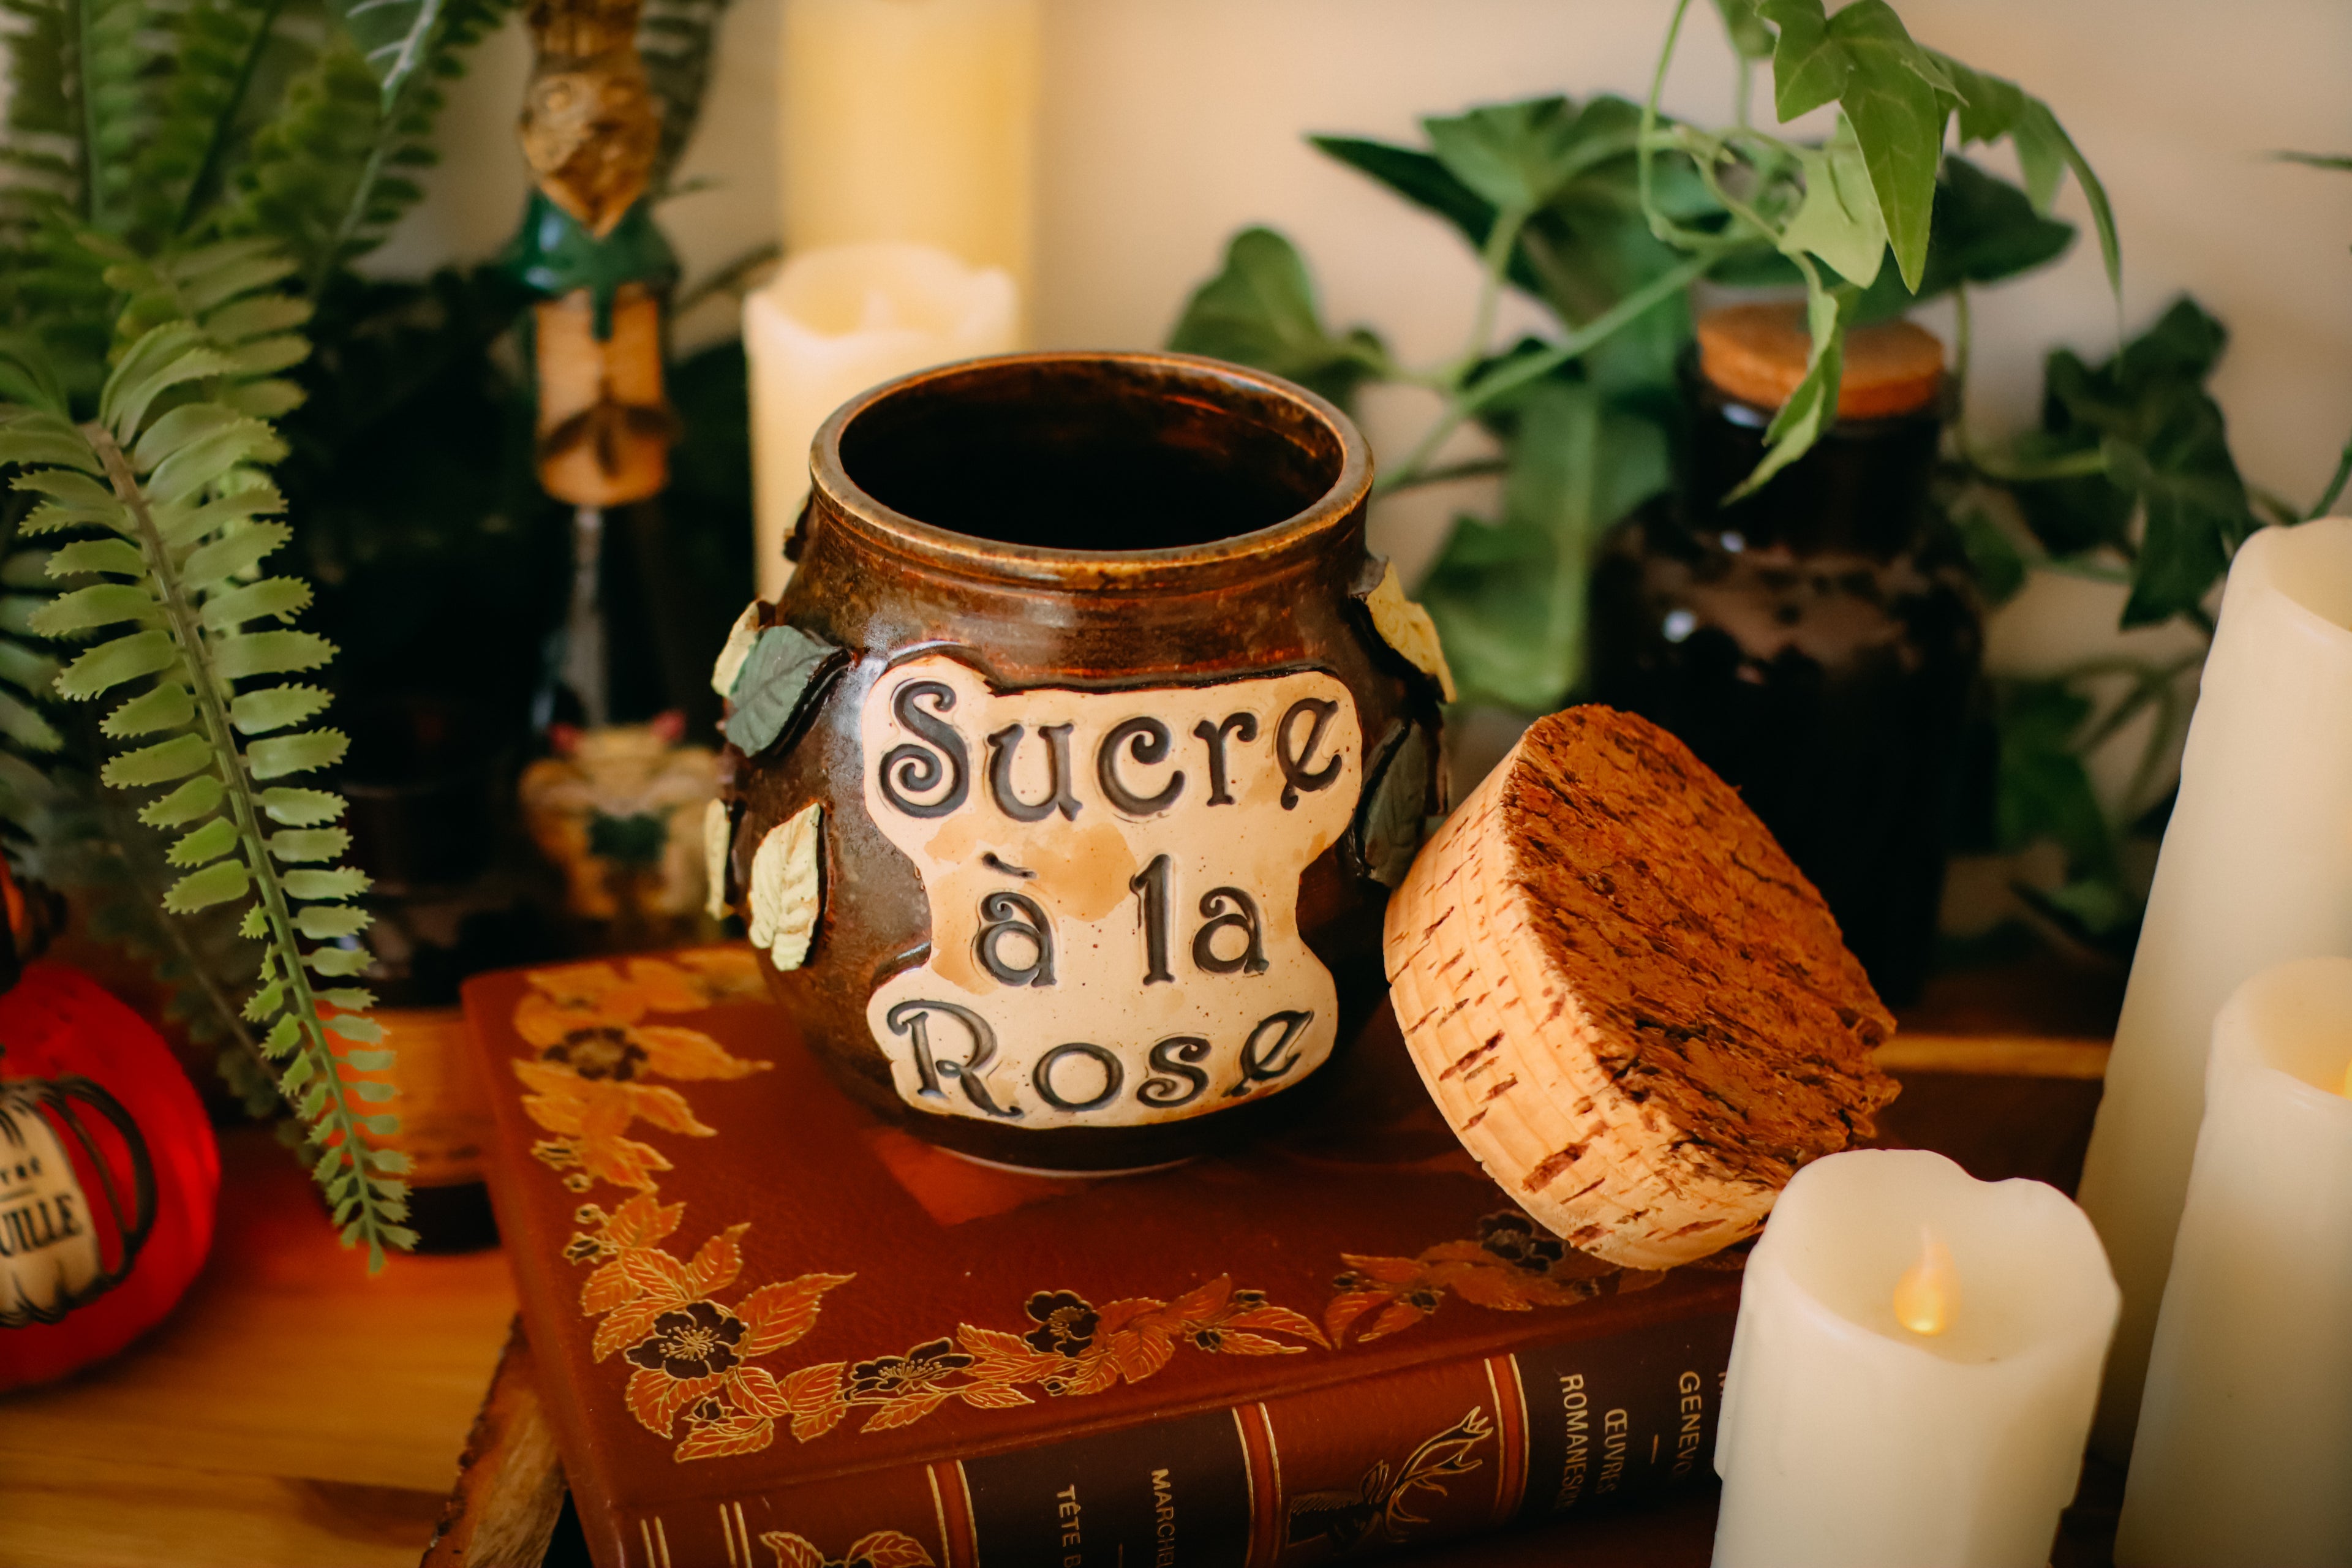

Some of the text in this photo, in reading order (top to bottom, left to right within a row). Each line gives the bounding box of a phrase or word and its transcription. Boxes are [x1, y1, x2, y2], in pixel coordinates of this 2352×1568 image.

[878, 678, 1342, 822] Sucre
[976, 853, 1270, 987] à la
[887, 1000, 1315, 1119] Rose
[1595, 1408, 1629, 1495] ŒUVRES
[1056, 1483, 1082, 1548] TÊTE
